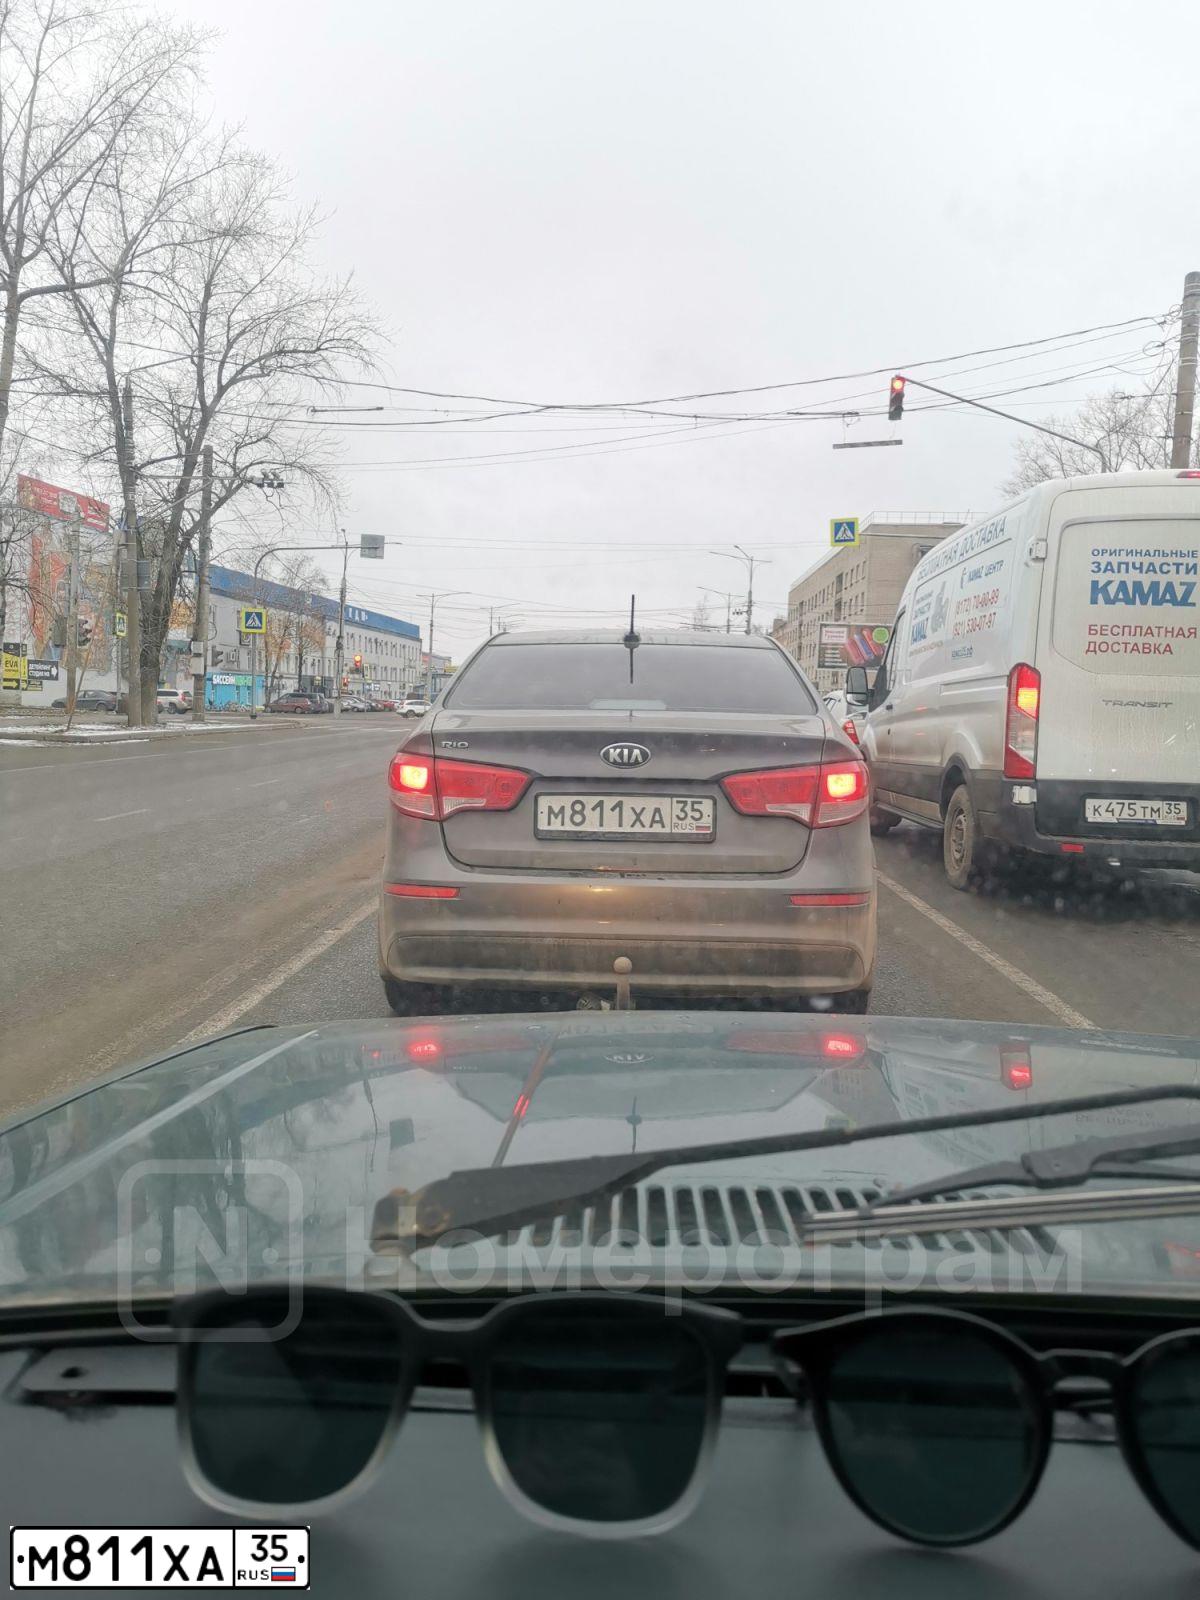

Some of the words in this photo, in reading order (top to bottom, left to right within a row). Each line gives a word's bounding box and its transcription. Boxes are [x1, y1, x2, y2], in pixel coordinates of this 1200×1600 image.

[959, 516, 1007, 560] ДОСТАВКА
[1091, 548, 1198, 559] ОРИГИНАЛЬНЫЕ
[1091, 561, 1198, 575] ЗАПЧАСТИ
[1090, 580, 1197, 607] KAMAZ
[1088, 624, 1197, 638] БЕСПЛАТНАЯ
[1085, 641, 1173, 655] ДОСТАВКА
[1102, 699, 1173, 708] TRANSIT
[441, 741, 469, 749] RIO
[608, 748, 644, 763] KIA
[547, 799, 666, 829] М811ХА
[675, 800, 704, 822] 35
[1165, 803, 1182, 815] 35
[673, 822, 695, 831] RUS
